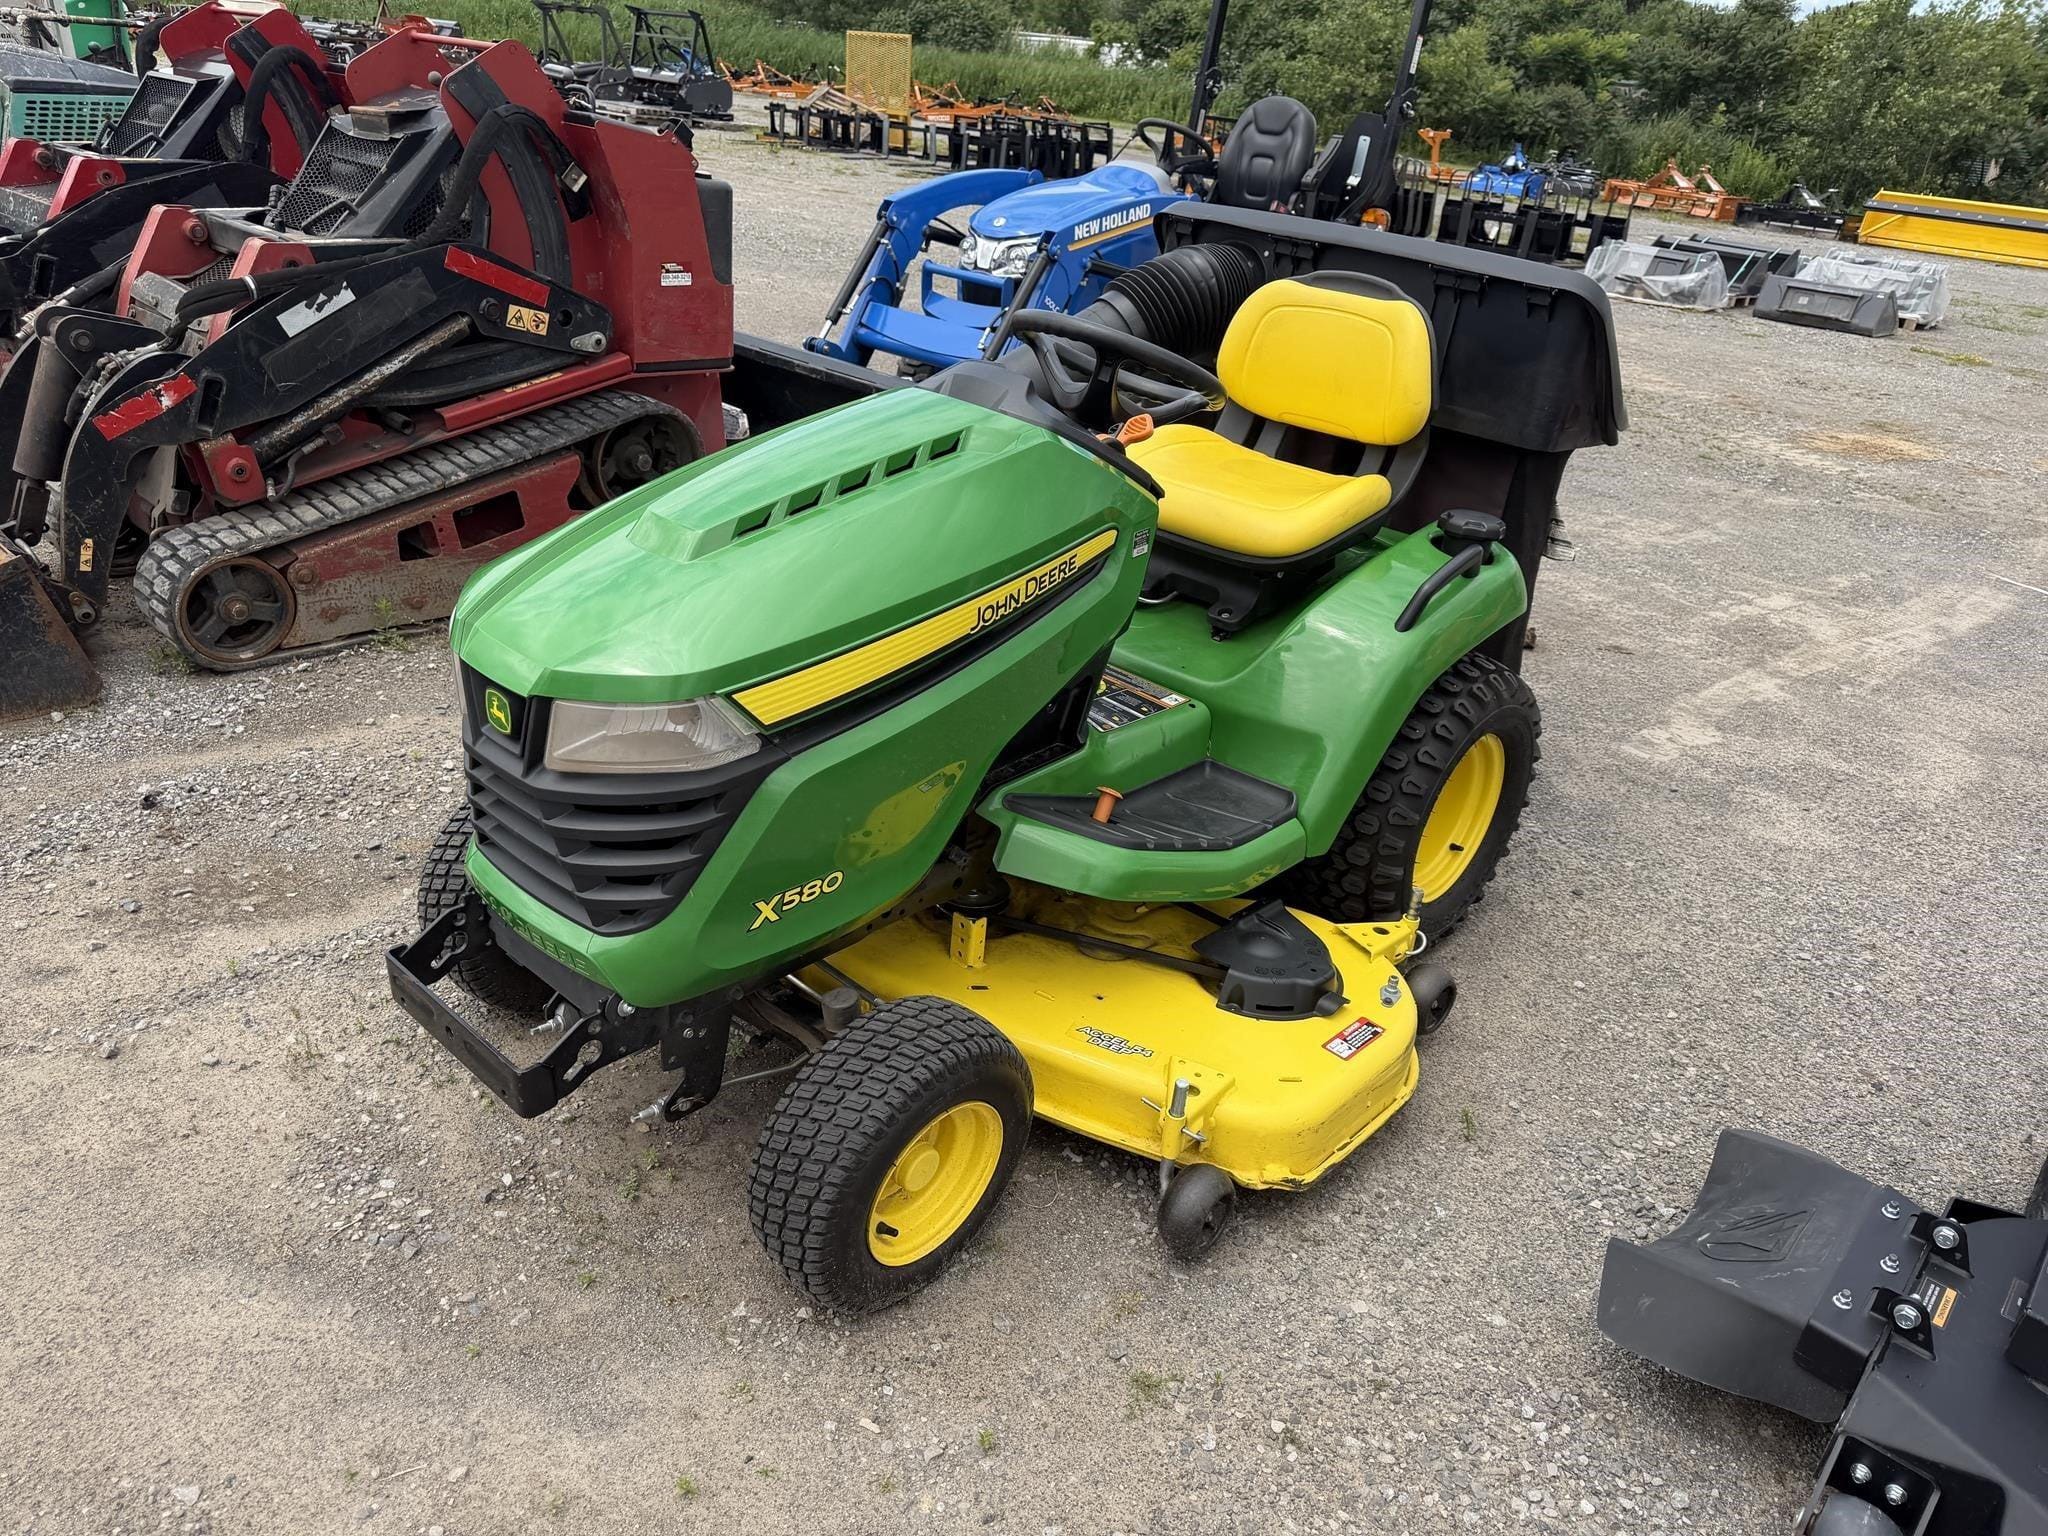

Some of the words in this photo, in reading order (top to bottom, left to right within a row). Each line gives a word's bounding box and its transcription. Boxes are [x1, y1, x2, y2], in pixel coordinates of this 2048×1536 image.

[1074, 218, 1101, 241] NEW
[1101, 203, 1151, 232] HOLLAND
[970, 588, 1021, 634] JOHN
[1024, 553, 1079, 602] DEERE
[746, 869, 845, 933] X580
[1086, 1036, 1132, 1055] DEEP
